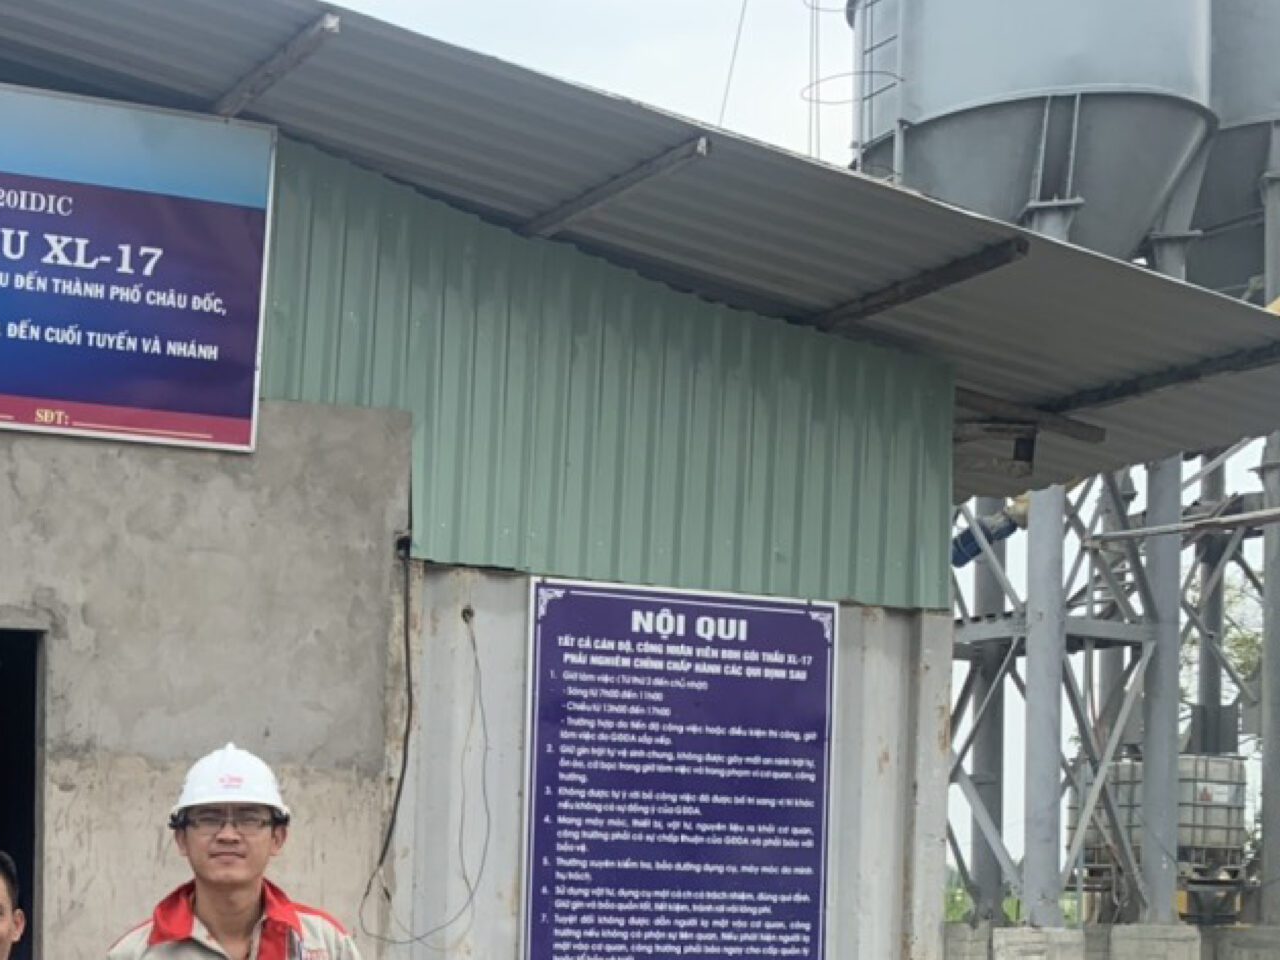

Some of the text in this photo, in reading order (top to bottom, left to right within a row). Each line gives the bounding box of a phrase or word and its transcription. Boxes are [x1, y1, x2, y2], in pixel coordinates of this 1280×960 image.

[40, 233, 163, 275] XL-17
[13, 270, 47, 291] ĐẾN
[51, 277, 104, 298] THÀNH
[109, 283, 142, 303] PHỐ
[146, 288, 187, 308] CHÂU
[191, 292, 226, 315] ĐỐC,
[7, 319, 39, 340] ĐẾN
[44, 324, 82, 344] CUỐI
[86, 329, 137, 351] TUYẾN
[142, 335, 161, 354] VÀ
[166, 340, 218, 360] NHÁNH
[34, 408, 68, 424] SĐT:
[631, 608, 746, 640] NỘI QUI
